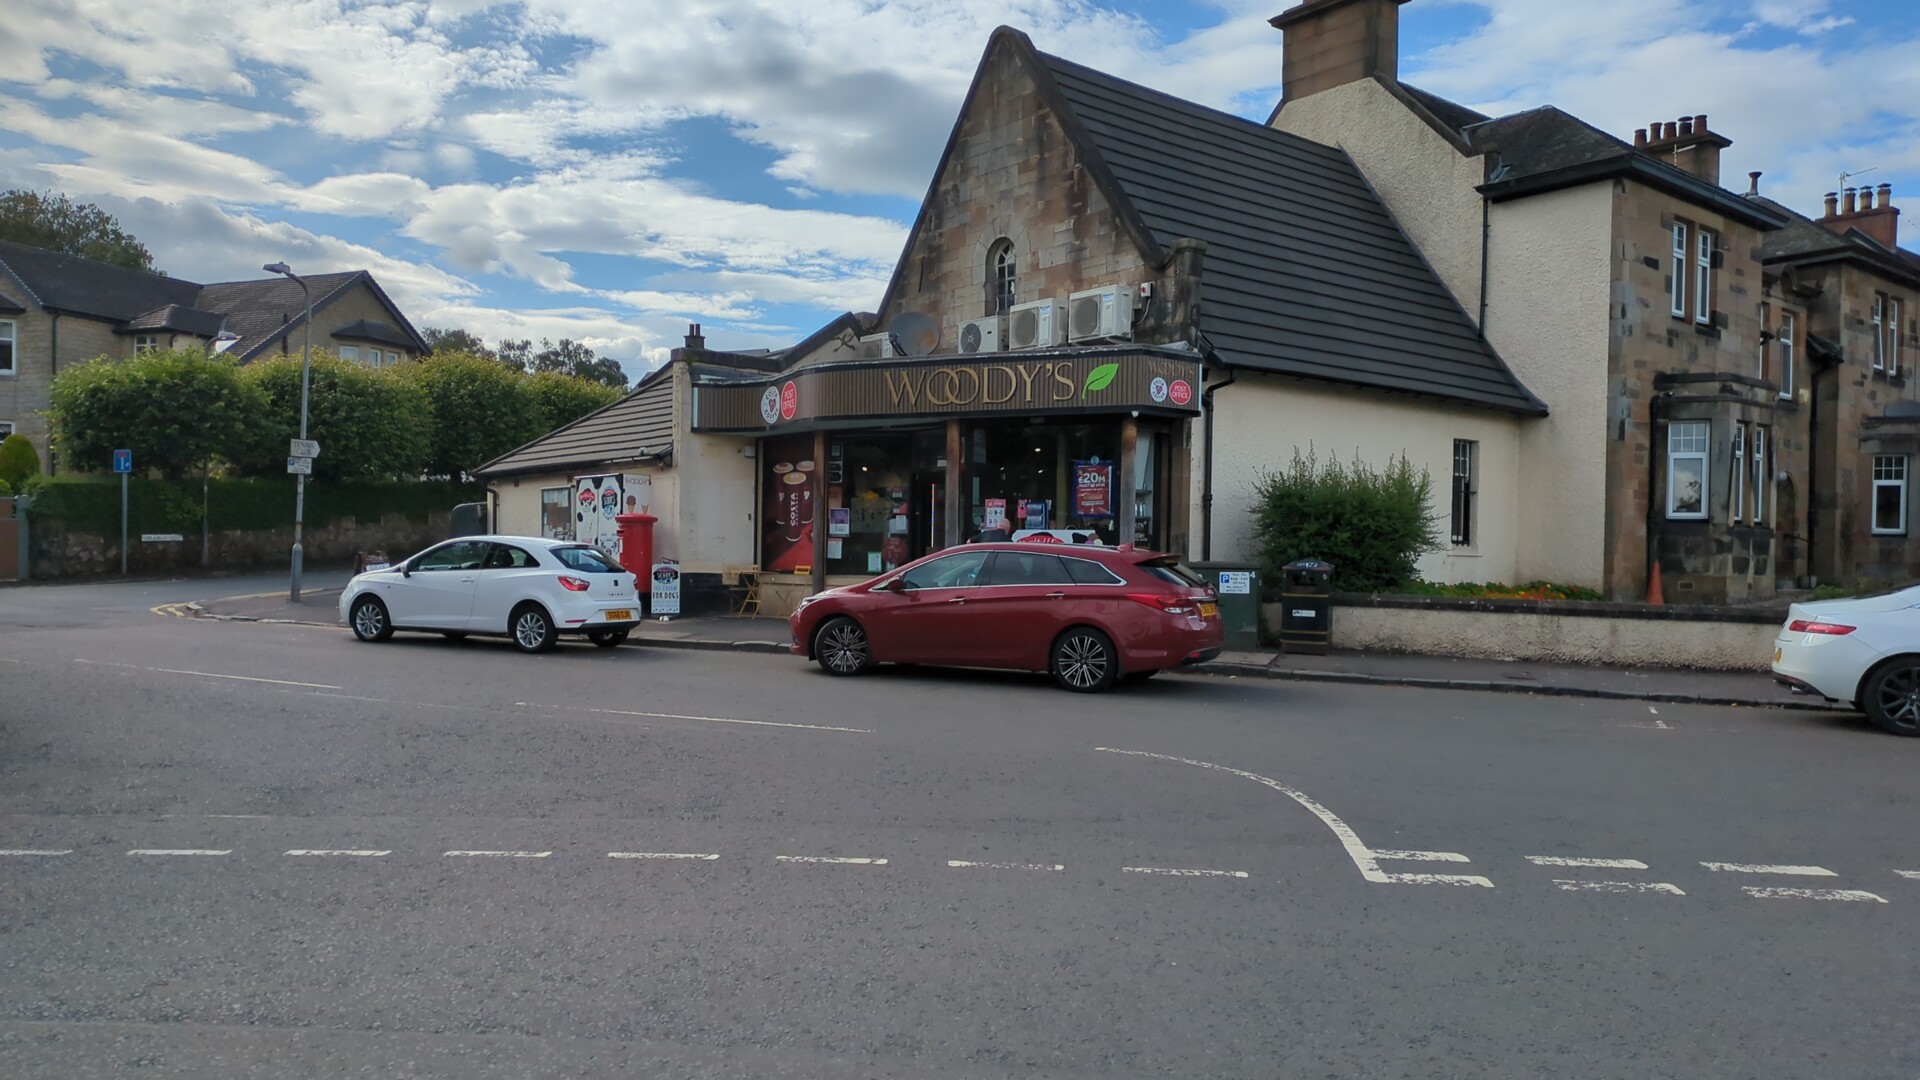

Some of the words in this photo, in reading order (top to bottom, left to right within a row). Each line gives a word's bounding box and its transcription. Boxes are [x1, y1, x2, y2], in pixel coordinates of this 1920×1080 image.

[1148, 361, 1195, 378] WOODY'S
[884, 362, 1076, 408] WOODY'S
[784, 389, 794, 400] POST
[1171, 390, 1188, 399] OFFICE
[783, 398, 795, 410] OFFICE
[296, 448, 312, 456] CLUB
[1078, 472, 1105, 483] £20M
[1250, 571, 1256, 579] 4
[652, 591, 663, 600] FOR
[664, 591, 679, 600] DOGS
